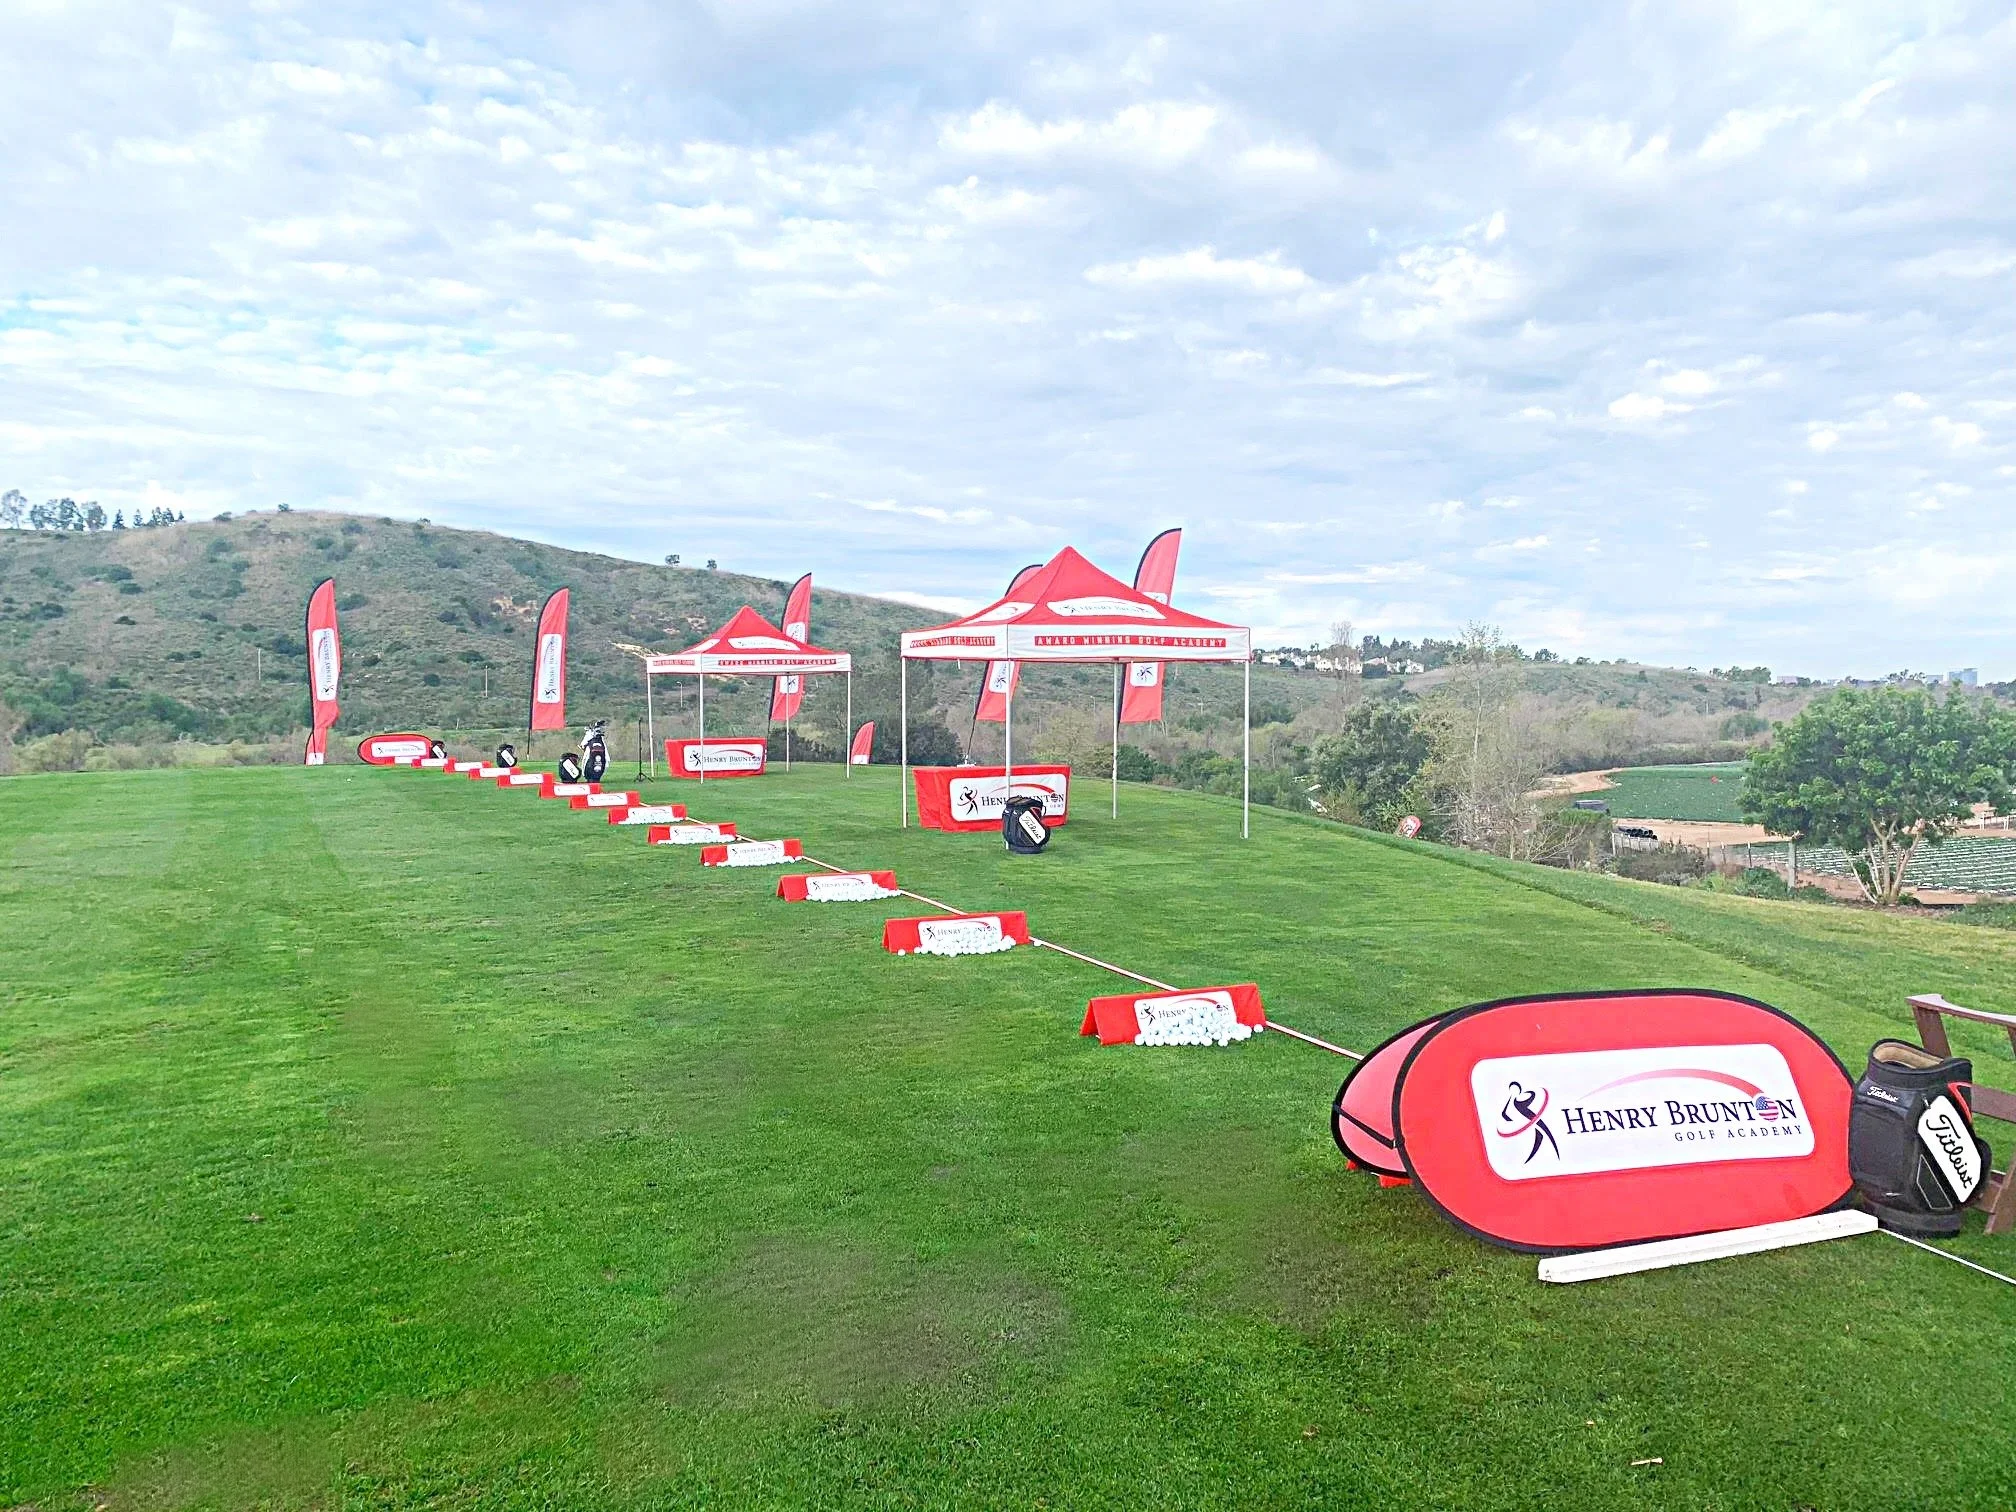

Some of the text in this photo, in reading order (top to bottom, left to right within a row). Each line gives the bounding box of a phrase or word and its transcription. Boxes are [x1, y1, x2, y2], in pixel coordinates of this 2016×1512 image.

[1038, 635, 1224, 647] AWARD WINNING GOLF ACADEMY
[703, 755, 728, 763] HENRY
[938, 928, 962, 936] HENRY
[1158, 1009, 1187, 1018] HENRY
[1561, 1096, 1798, 1135] HENRY BRUNTON
[1674, 1125, 1804, 1142] GOLF ACADEMY
[1926, 1114, 1973, 1189] Titleist
